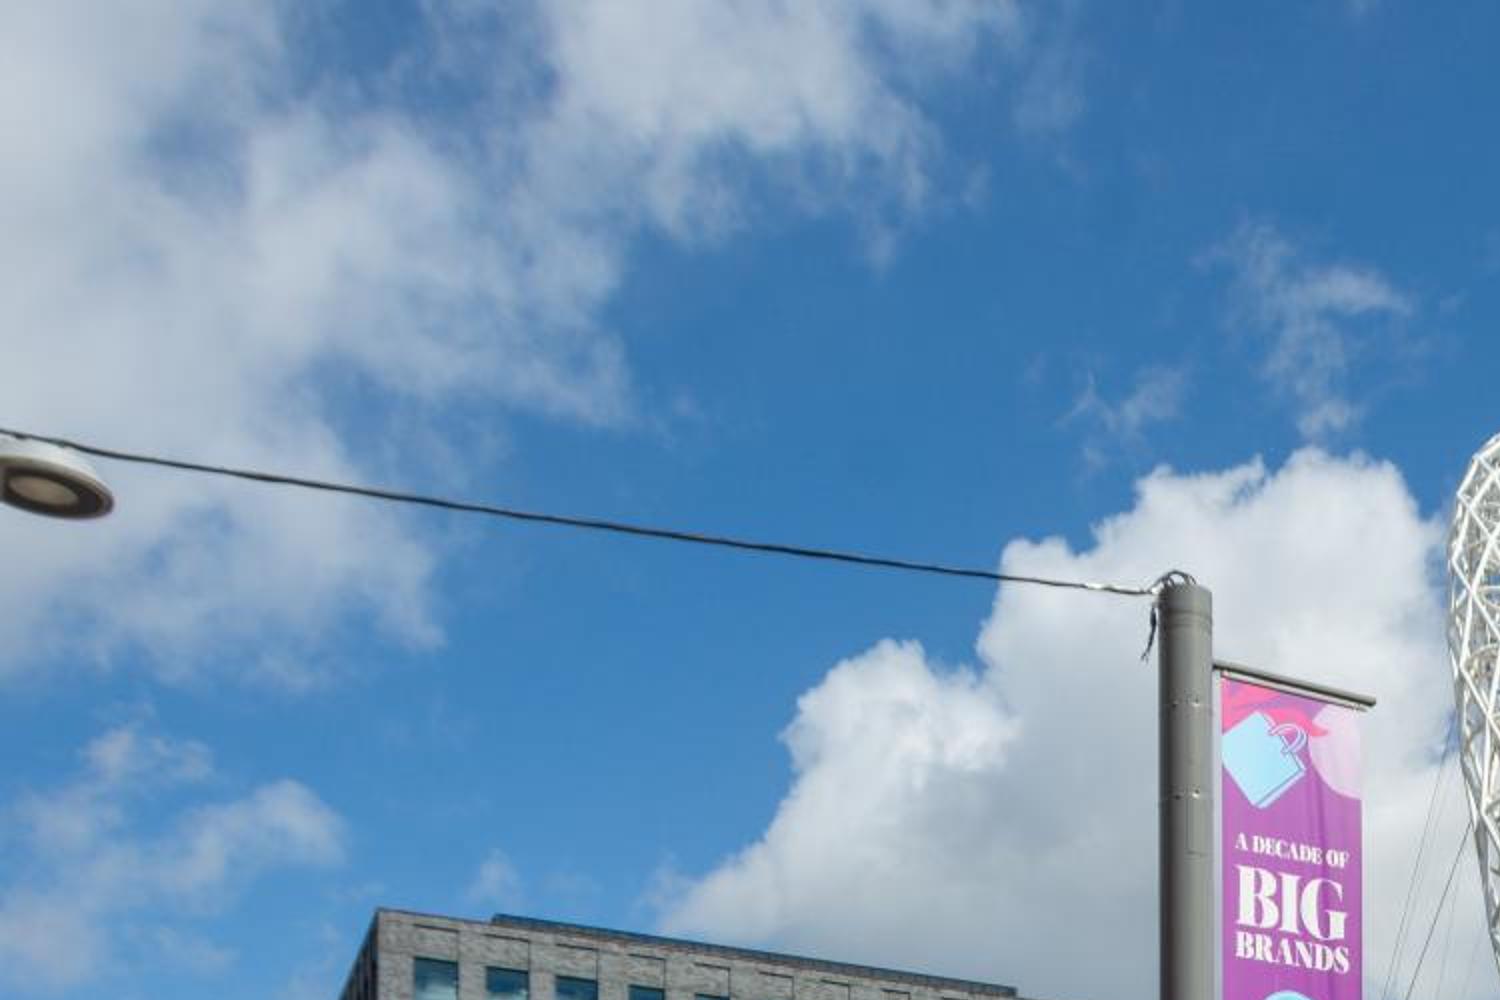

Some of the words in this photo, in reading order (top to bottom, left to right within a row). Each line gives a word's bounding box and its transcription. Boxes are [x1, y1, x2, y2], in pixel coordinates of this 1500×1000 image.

[1235, 832, 1248, 851] A
[1252, 835, 1323, 865] DECADE
[1325, 849, 1350, 869] OF
[1234, 863, 1347, 941] BIG
[1235, 930, 1350, 974] BRANDS
